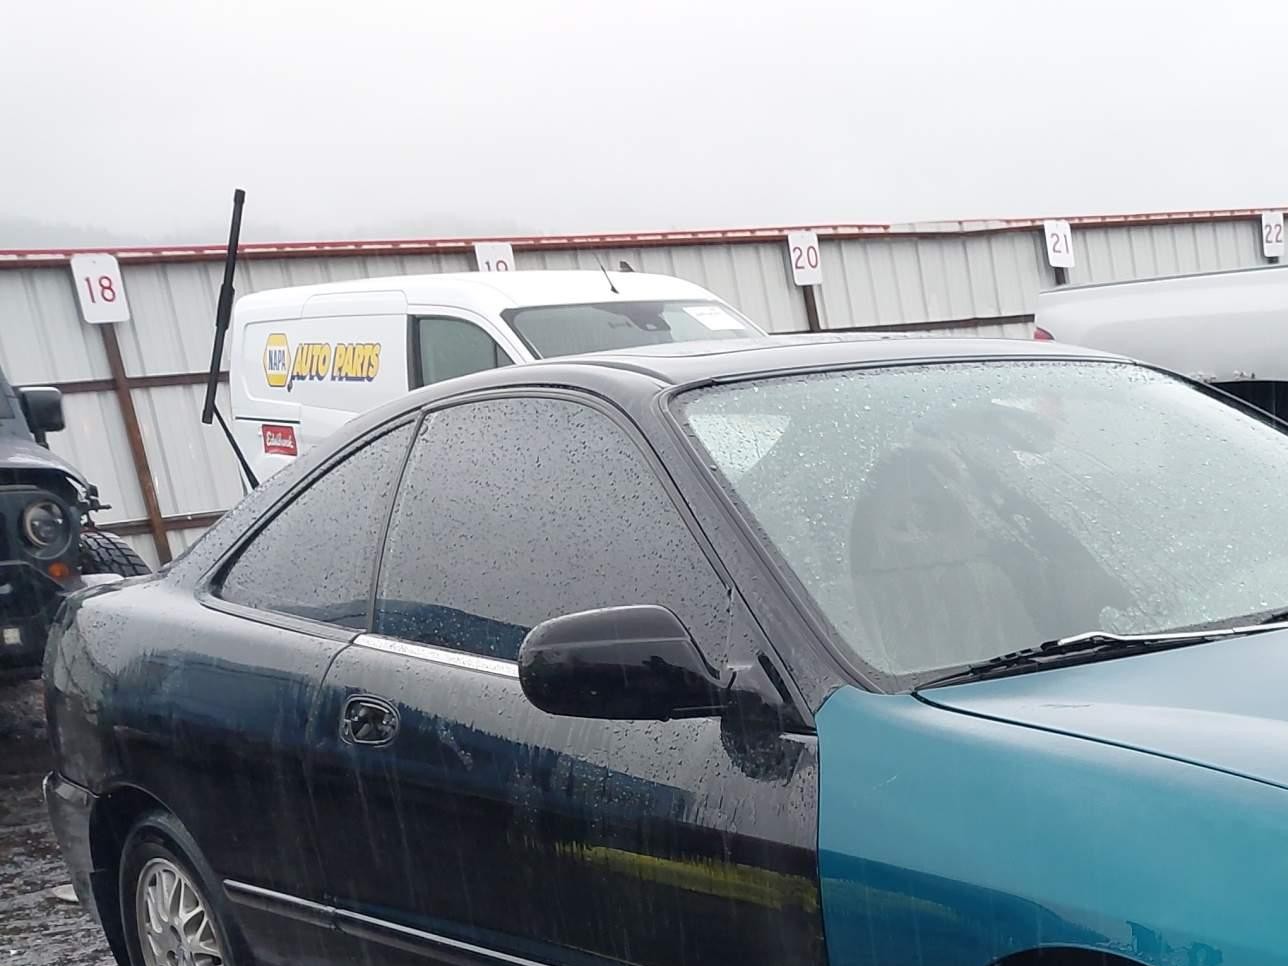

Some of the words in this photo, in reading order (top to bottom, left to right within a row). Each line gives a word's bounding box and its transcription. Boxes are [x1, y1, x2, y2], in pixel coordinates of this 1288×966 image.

[1050, 232, 1070, 254] 21
[1264, 224, 1283, 244] 22
[792, 245, 818, 269] 20
[84, 276, 116, 304] 18
[268, 349, 286, 371] NAPA
[291, 342, 331, 381] AUTO
[331, 342, 381, 382] PARTS
